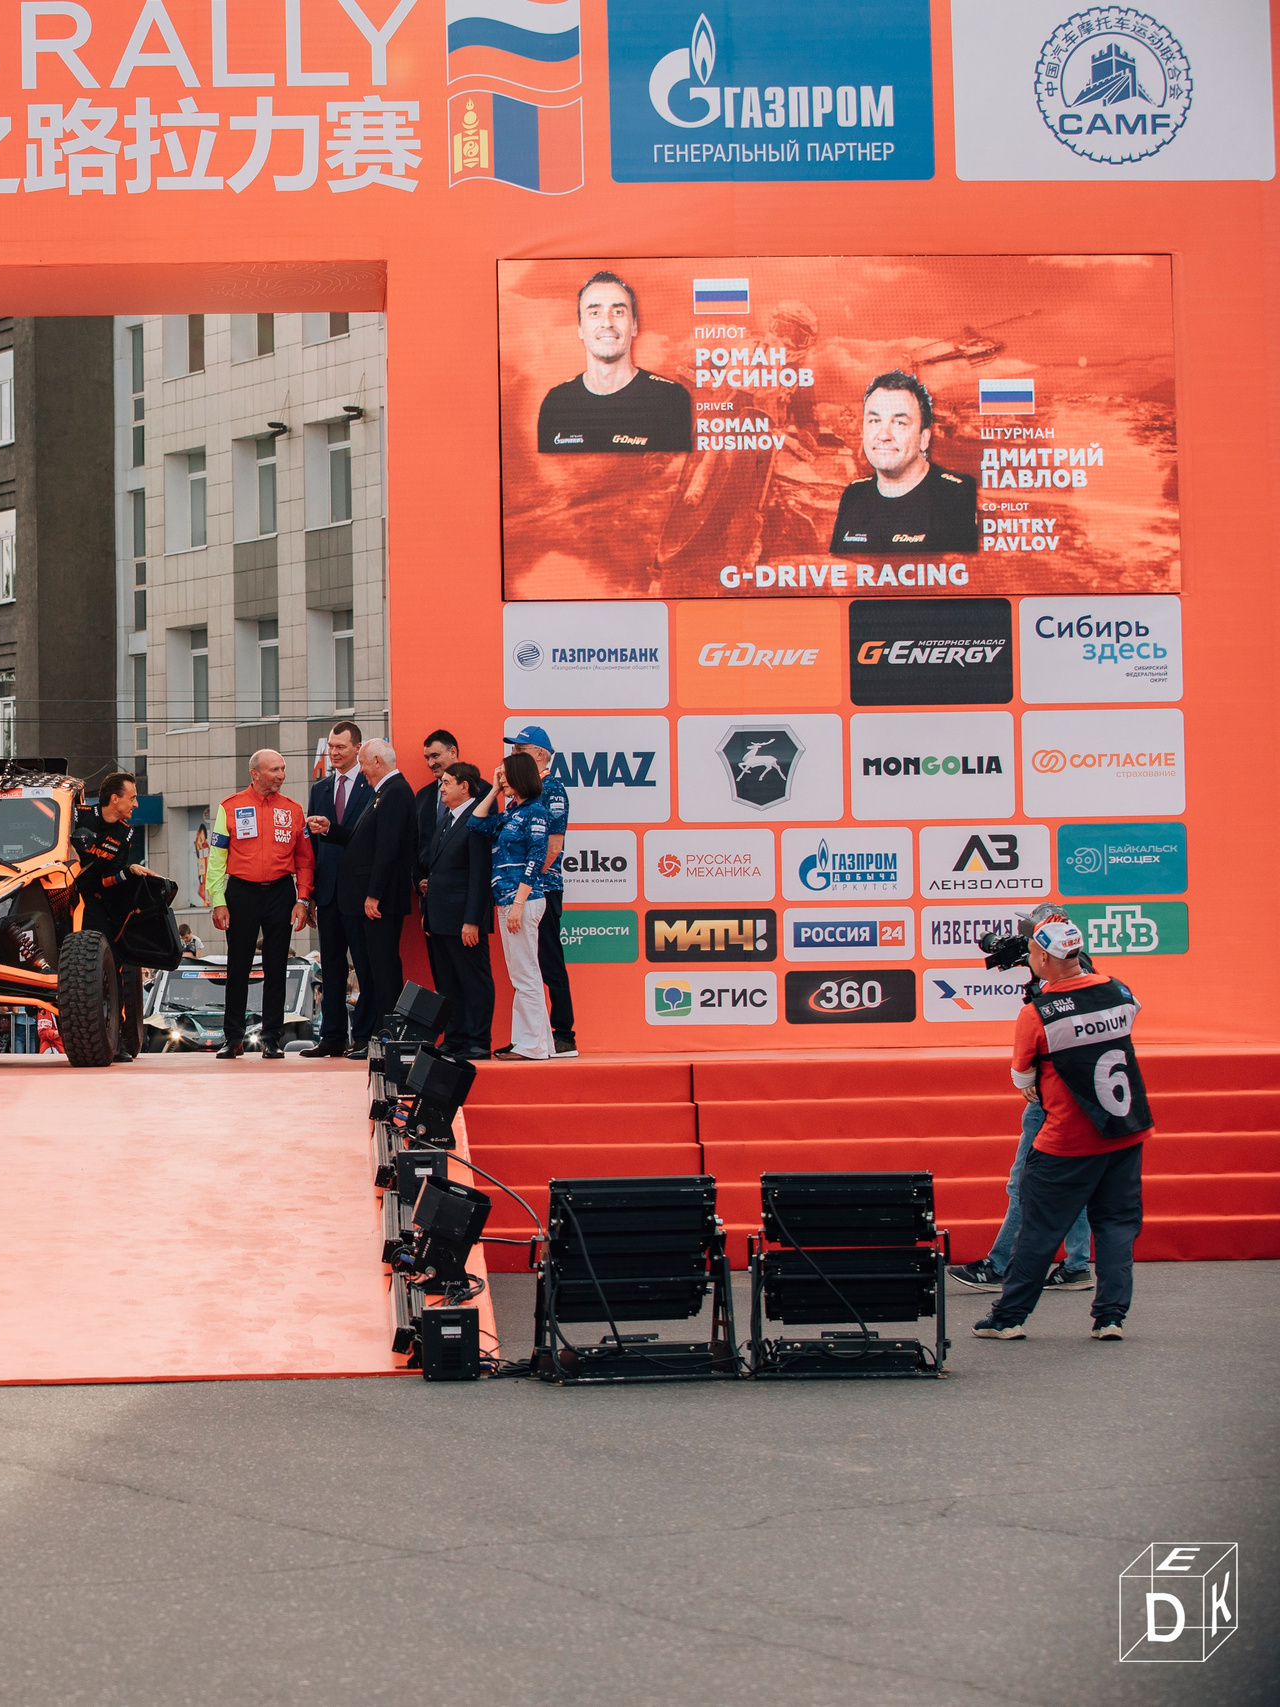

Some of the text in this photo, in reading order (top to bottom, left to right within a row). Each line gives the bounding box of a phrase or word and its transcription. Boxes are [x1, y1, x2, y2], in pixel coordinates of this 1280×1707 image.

[21, 0, 418, 89] RALLY
[723, 84, 895, 129] ГАЗПРОМ
[1058, 113, 1171, 135] CAMF
[653, 139, 895, 163] ГЕНЕРАЛЬНЫЙ ПАРТНЕР
[695, 327, 746, 339] ПИЛОТ
[695, 347, 786, 367] РОМАН
[695, 368, 814, 388] РУСИНОВ
[696, 402, 734, 411] DRIVER
[696, 418, 769, 433] ROMAN
[980, 427, 1055, 440] ШТУРМАН
[696, 435, 786, 451] RUSINOV
[980, 442, 1104, 470] ДМИТРИЙ
[981, 469, 1088, 488] ПАВЛОВ
[982, 502, 1029, 512] CO-PILOT
[982, 518, 1057, 535] DMITRY
[982, 536, 1059, 551] PAVLOV
[720, 563, 969, 588] G-DRIVE RACING
[1035, 614, 1150, 643] Сибирь
[552, 648, 659, 662] ГАЗПРОМБАНК
[1082, 642, 1167, 664] здесь
[863, 756, 1002, 776] MONGOLIA
[1070, 752, 1176, 768] СОГЛАСИЕ
[549, 751, 656, 787] AMAZ
[1116, 770, 1176, 779] страхование
[1109, 844, 1178, 853] БАЙКАЛЬСК
[563, 850, 628, 873] elko
[686, 854, 751, 865] РУССКАЯ
[832, 853, 897, 870] ГАЗПРОМ
[1109, 856, 1160, 865] ЭКО.ЦЕХ
[686, 866, 761, 877] МЕХАНИКА
[834, 873, 896, 882] ДОБЫЧА
[832, 883, 897, 891] ИРКУТСК
[929, 878, 1043, 891] ЛЕНЗОЛОТО
[571, 926, 629, 936] НОВОСТИ
[654, 919, 767, 951] МАТЧ!
[801, 926, 903, 942] РОССИЯ 24
[1088, 906, 1159, 953] НТВ
[560, 936, 584, 946] ОРТ
[820, 980, 881, 1009] 360
[964, 985, 1024, 995] ТРИКОЛ
[700, 989, 767, 1008] 2ГИС
[1053, 997, 1074, 1006] SILK
[1056, 1003, 1075, 1013] WAY
[1074, 1015, 1127, 1037] PODIUM
[1094, 1049, 1131, 1117] 6
